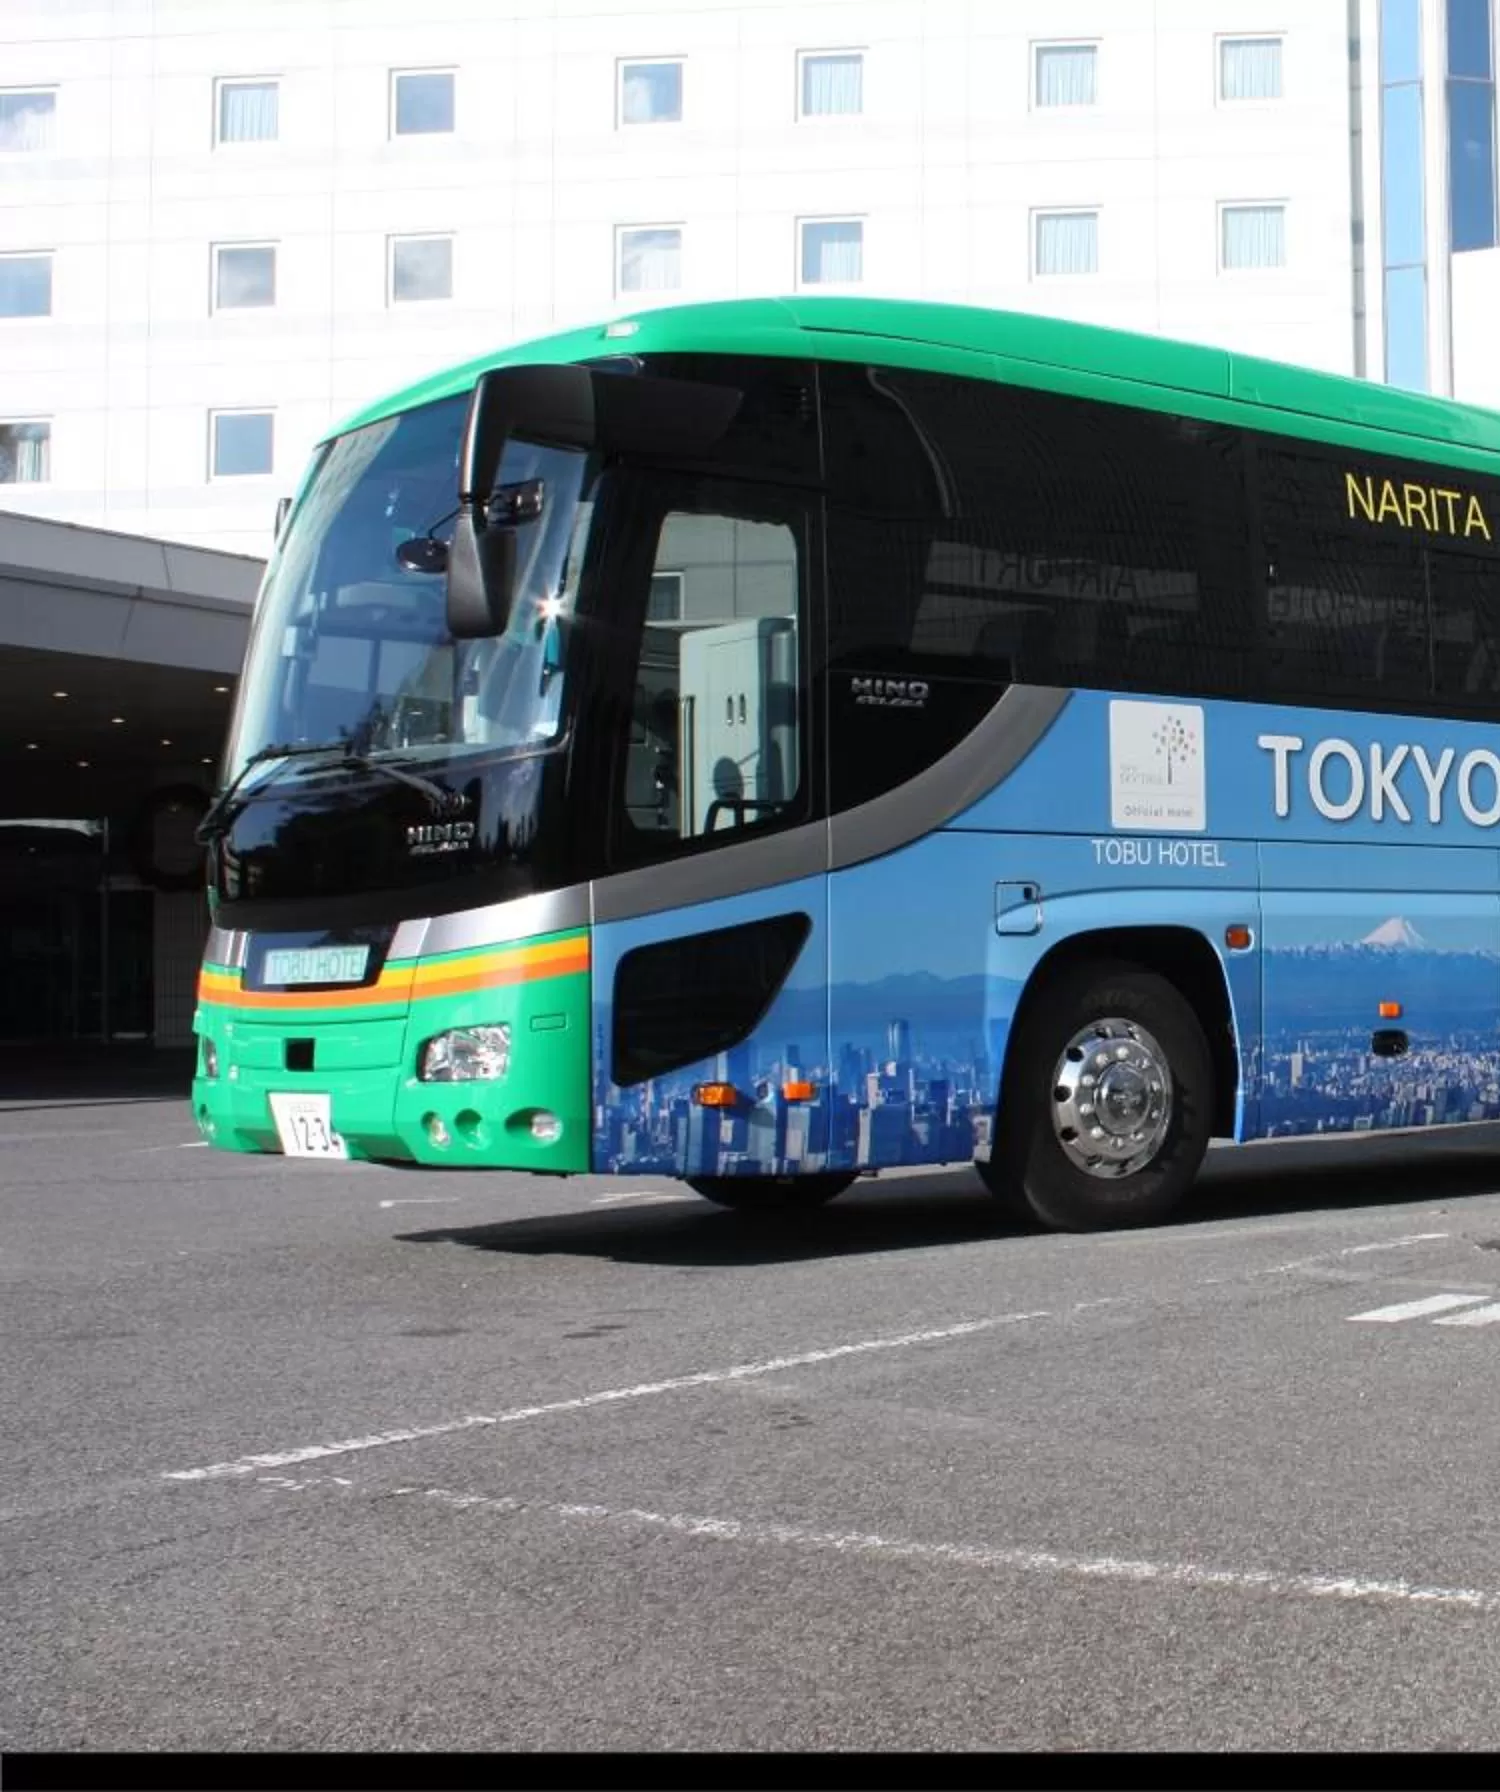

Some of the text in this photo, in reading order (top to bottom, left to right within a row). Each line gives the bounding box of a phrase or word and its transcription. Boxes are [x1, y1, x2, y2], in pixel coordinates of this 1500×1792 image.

[1345, 473, 1491, 541] NARITA
[851, 677, 929, 700] HINO
[407, 820, 475, 845] HINO
[1091, 838, 1228, 868] TOBU HOTEL
